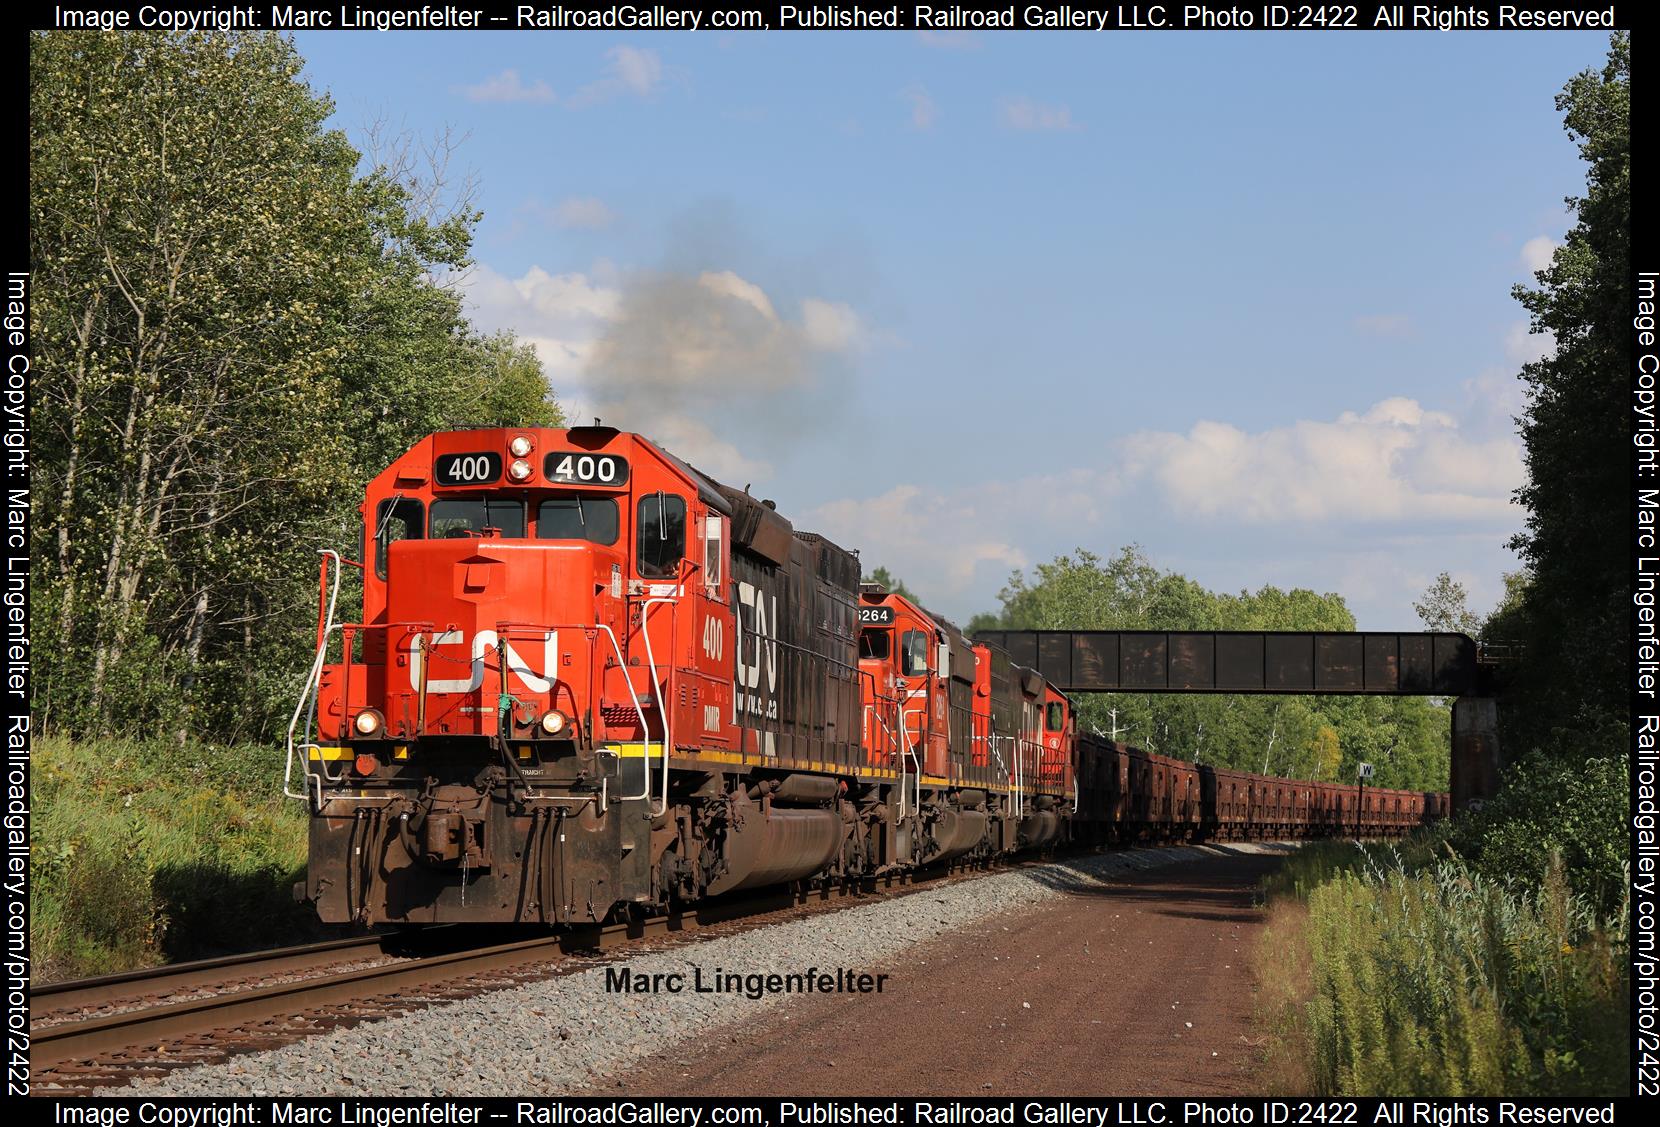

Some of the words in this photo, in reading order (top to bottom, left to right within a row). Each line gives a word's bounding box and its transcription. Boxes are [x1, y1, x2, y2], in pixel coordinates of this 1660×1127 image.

[448, 456, 490, 481] 400
[555, 456, 615, 482] 400
[702, 613, 723, 662] 400
[410, 630, 558, 694] CN
[703, 704, 721, 733] DMIR
[1363, 765, 1371, 775] W
